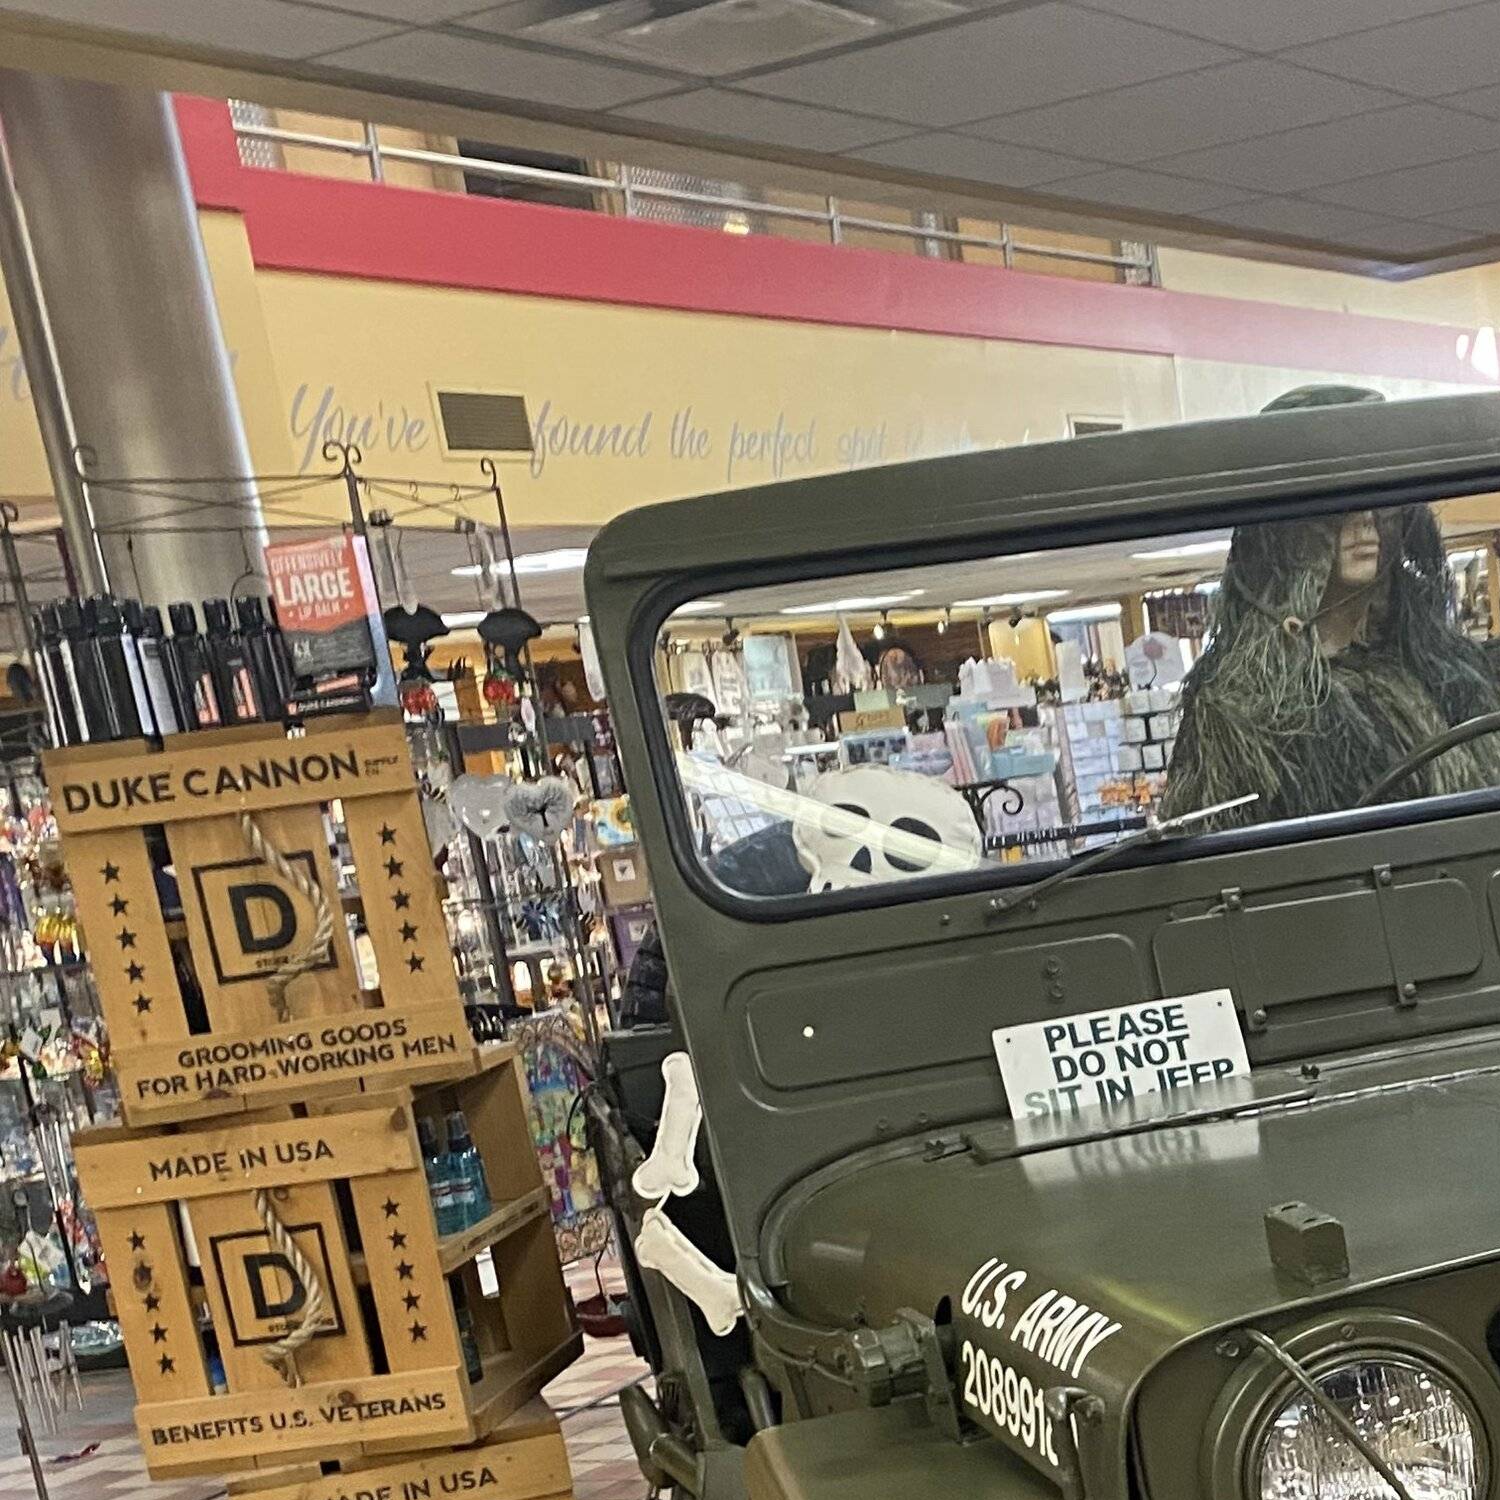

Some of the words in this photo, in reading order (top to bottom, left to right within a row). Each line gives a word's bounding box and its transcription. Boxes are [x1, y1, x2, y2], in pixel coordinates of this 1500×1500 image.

[290, 383, 430, 474] You've
[530, 399, 653, 480] found
[670, 406, 714, 459] the
[727, 411, 817, 484] perfect
[275, 567, 355, 608] LARGE
[63, 772, 176, 814] DUKE
[184, 750, 359, 798] CANNON
[228, 884, 297, 954] D
[178, 1032, 313, 1068] GROOMING
[321, 1018, 408, 1047] GOODS
[1043, 1004, 1188, 1053] PLEASE
[137, 1073, 188, 1099] FOR
[403, 1034, 456, 1060] MEN
[1052, 1050, 1106, 1083] DO
[1115, 1034, 1190, 1072] NOT
[1024, 1084, 1082, 1119] SIT
[1096, 1076, 1134, 1104] IN
[149, 1152, 232, 1181] MADE
[239, 1146, 268, 1170] IN
[276, 1139, 335, 1164] USA
[962, 1257, 1027, 1329] U.S.
[1010, 1289, 1123, 1379] ARMY
[151, 1415, 263, 1447] BENEFITS
[270, 1409, 314, 1430] U.S.
[319, 1392, 447, 1423] VETERANS
[439, 1466, 499, 1494] USA
